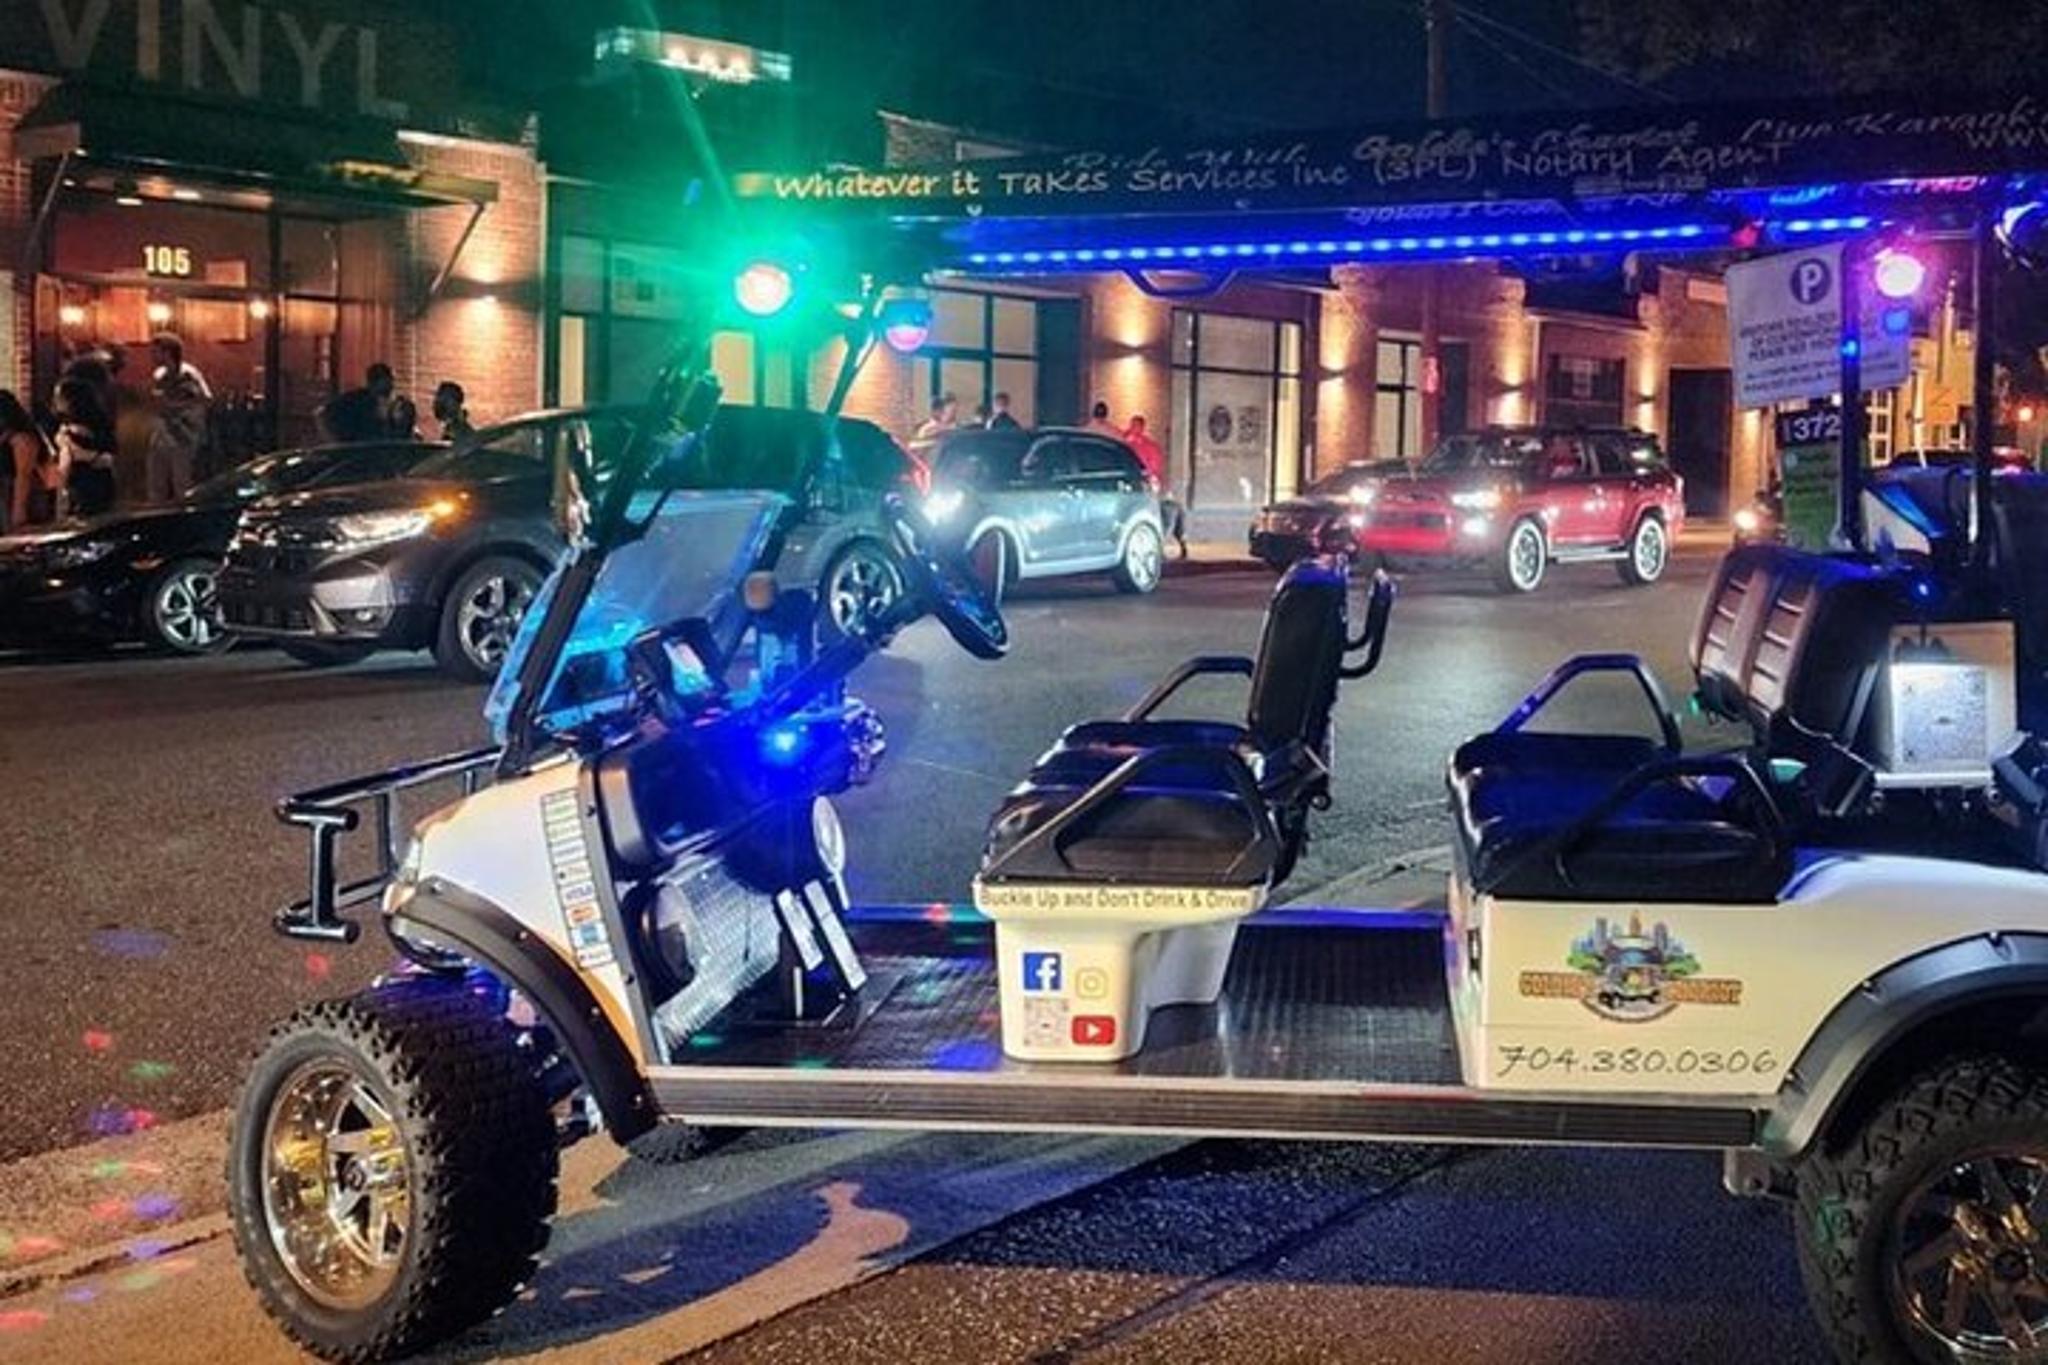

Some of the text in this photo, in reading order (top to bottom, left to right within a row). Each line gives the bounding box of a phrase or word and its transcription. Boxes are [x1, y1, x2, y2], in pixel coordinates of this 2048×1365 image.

[39, 0, 409, 120] VINYL
[952, 169, 980, 195] it
[1126, 165, 1278, 192] Services
[1293, 163, 1350, 186] Inc
[1503, 149, 1634, 178] Notary
[142, 244, 191, 277] 105
[1038, 888, 1060, 910] Up
[1063, 888, 1093, 908] and
[1098, 886, 1139, 908] Don't
[1144, 888, 1186, 908] Drink
[1190, 889, 1202, 908] &
[1206, 888, 1249, 909] Drive
[1497, 1044, 1778, 1078] 704.380.0306
